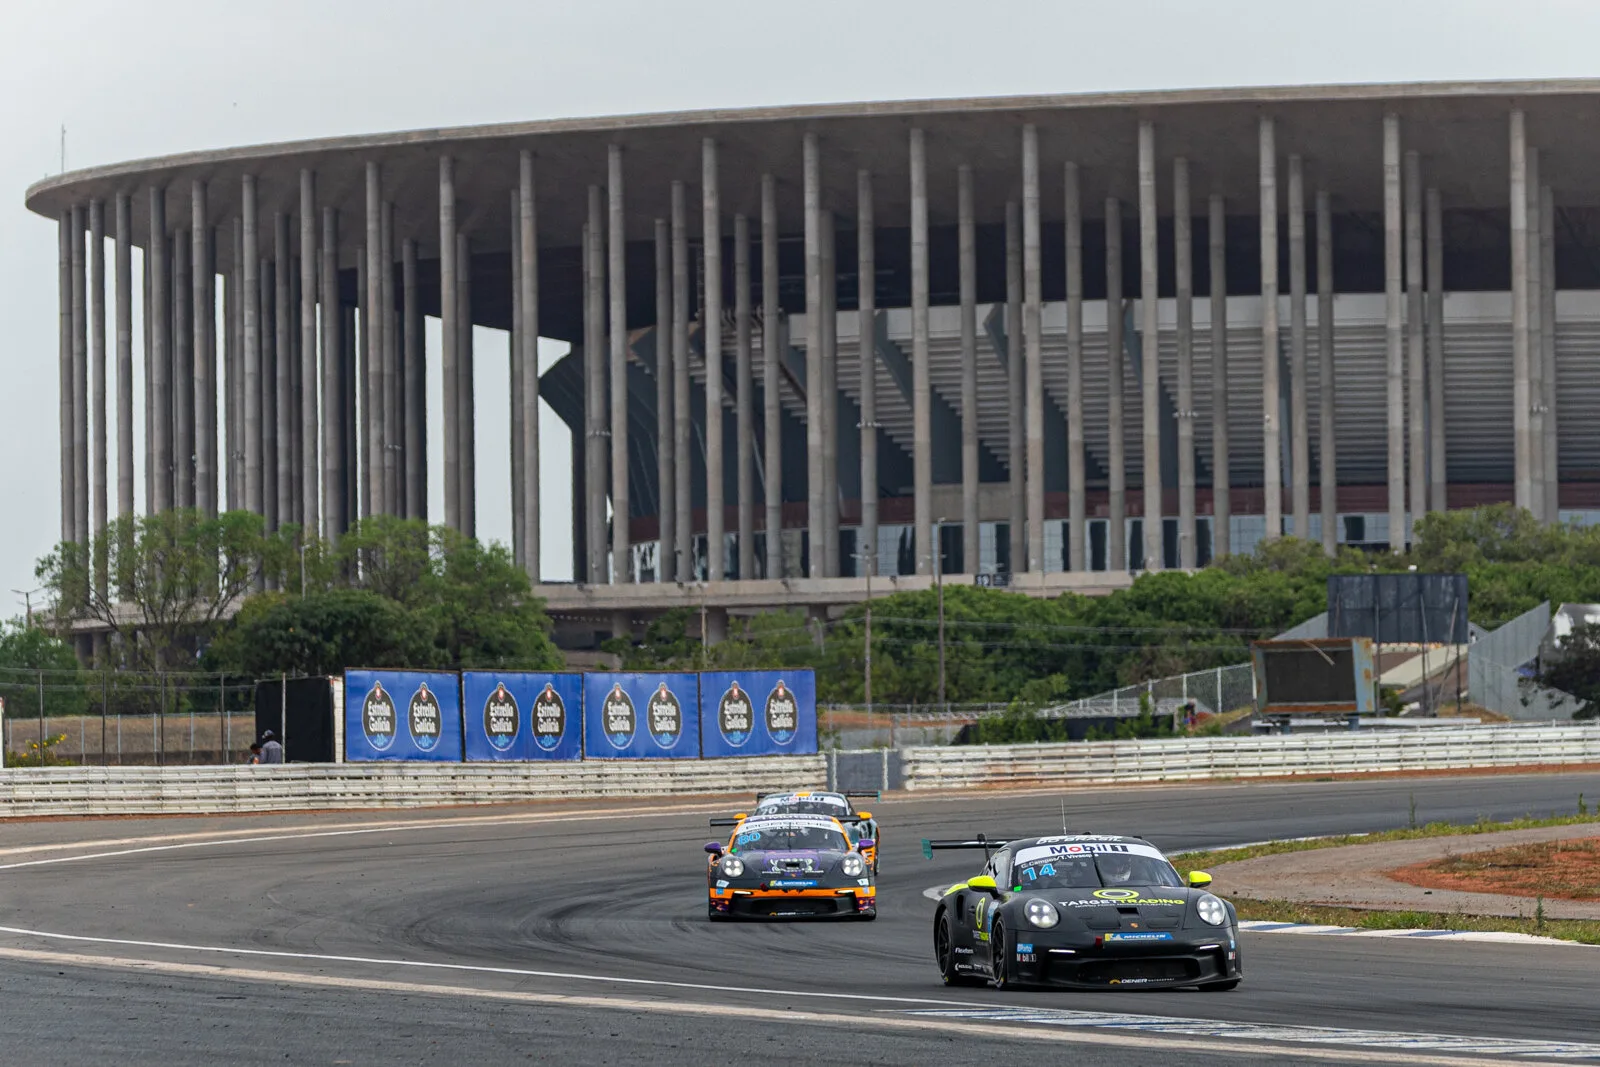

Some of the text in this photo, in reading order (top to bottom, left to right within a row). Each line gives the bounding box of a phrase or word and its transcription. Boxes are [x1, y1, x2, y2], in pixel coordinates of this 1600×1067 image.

[368, 700, 391, 717] Estrella
[413, 702, 436, 717] Estrella
[490, 702, 513, 717] Estrella
[537, 702, 560, 717] Estrella
[608, 701, 630, 716] Estrella
[653, 701, 676, 716] Estrella
[724, 700, 747, 715] Estrella
[770, 699, 793, 714] Estrella
[369, 717, 391, 732] Galicia
[414, 717, 436, 733] Galicia
[490, 717, 513, 733] Galicia
[538, 717, 559, 733] Galicia
[609, 716, 630, 731] Galicia
[654, 716, 676, 731] Galicia
[725, 714, 747, 729] Galicia
[771, 714, 793, 728] Galicia
[738, 832, 761, 845] 80
[1050, 844, 1107, 855] Mobil
[1022, 862, 1057, 881] 14
